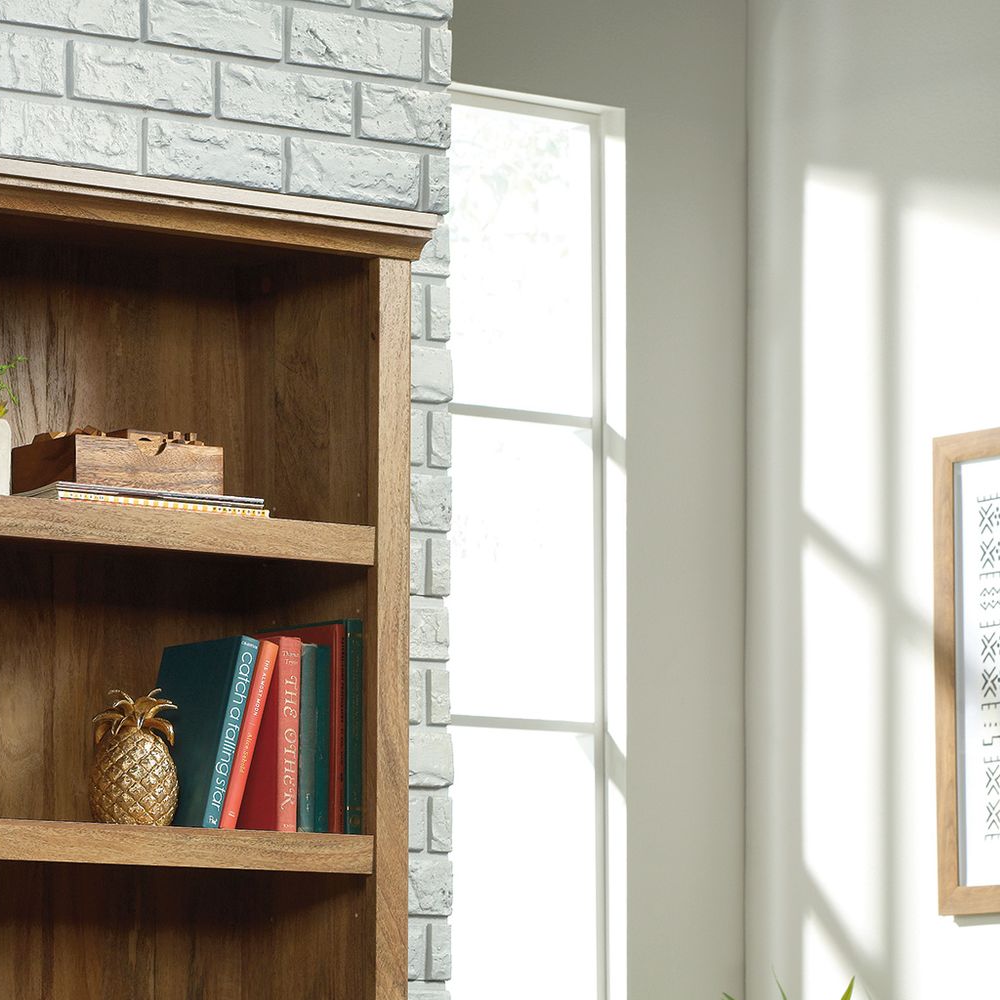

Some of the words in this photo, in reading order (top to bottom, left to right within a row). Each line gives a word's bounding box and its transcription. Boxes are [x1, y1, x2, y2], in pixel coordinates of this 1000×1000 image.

[232, 651, 253, 707] catch
[283, 675, 298, 719] THE
[229, 708, 241, 720] a
[215, 722, 240, 776] falling
[280, 727, 297, 811] OTHER
[211, 777, 226, 812] star
